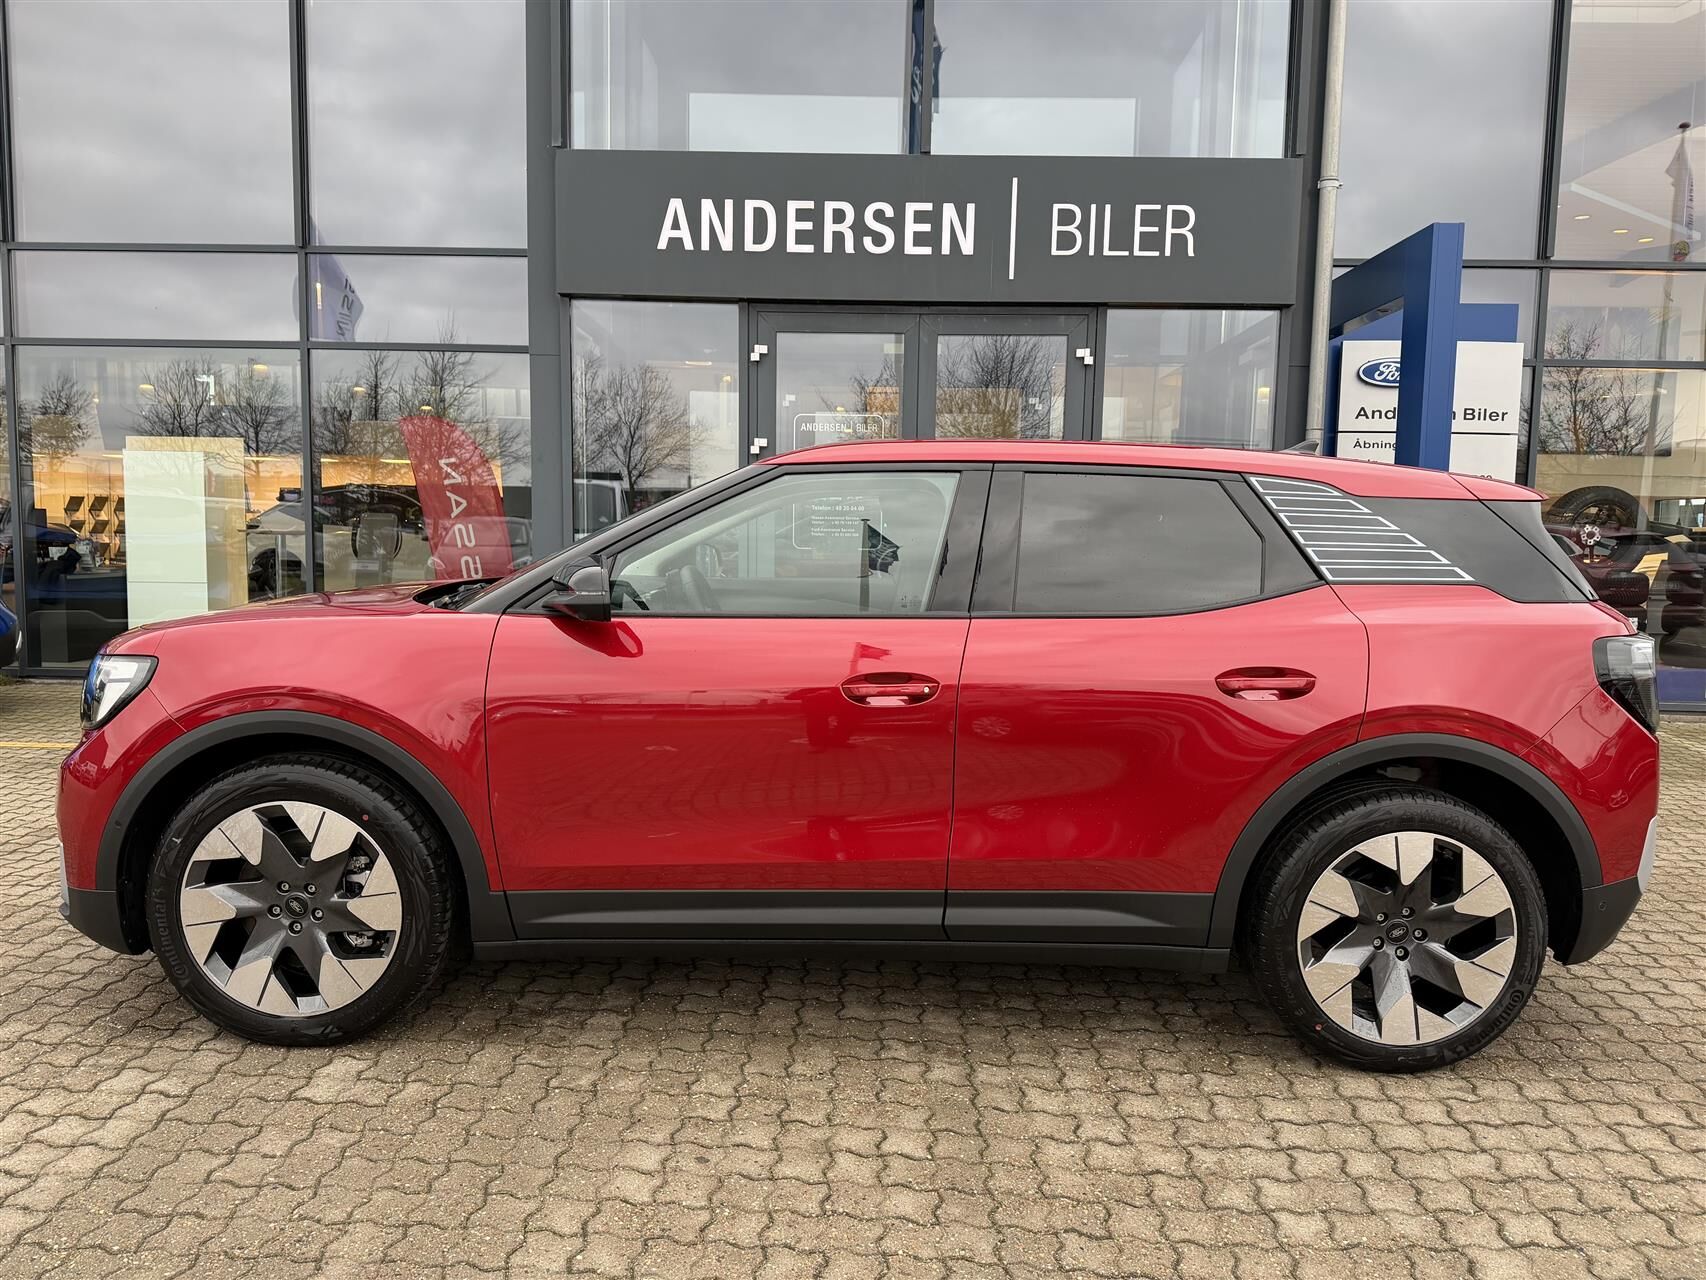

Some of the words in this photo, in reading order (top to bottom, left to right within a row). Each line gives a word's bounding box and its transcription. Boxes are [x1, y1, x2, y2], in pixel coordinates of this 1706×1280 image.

[657, 197, 976, 256] ANDERSEN
[1050, 203, 1196, 258] BILER
[800, 422, 847, 432] ANDERSEN
[856, 423, 878, 432] BILER
[1463, 407, 1509, 422] Biler
[152, 898, 189, 979] Continental
